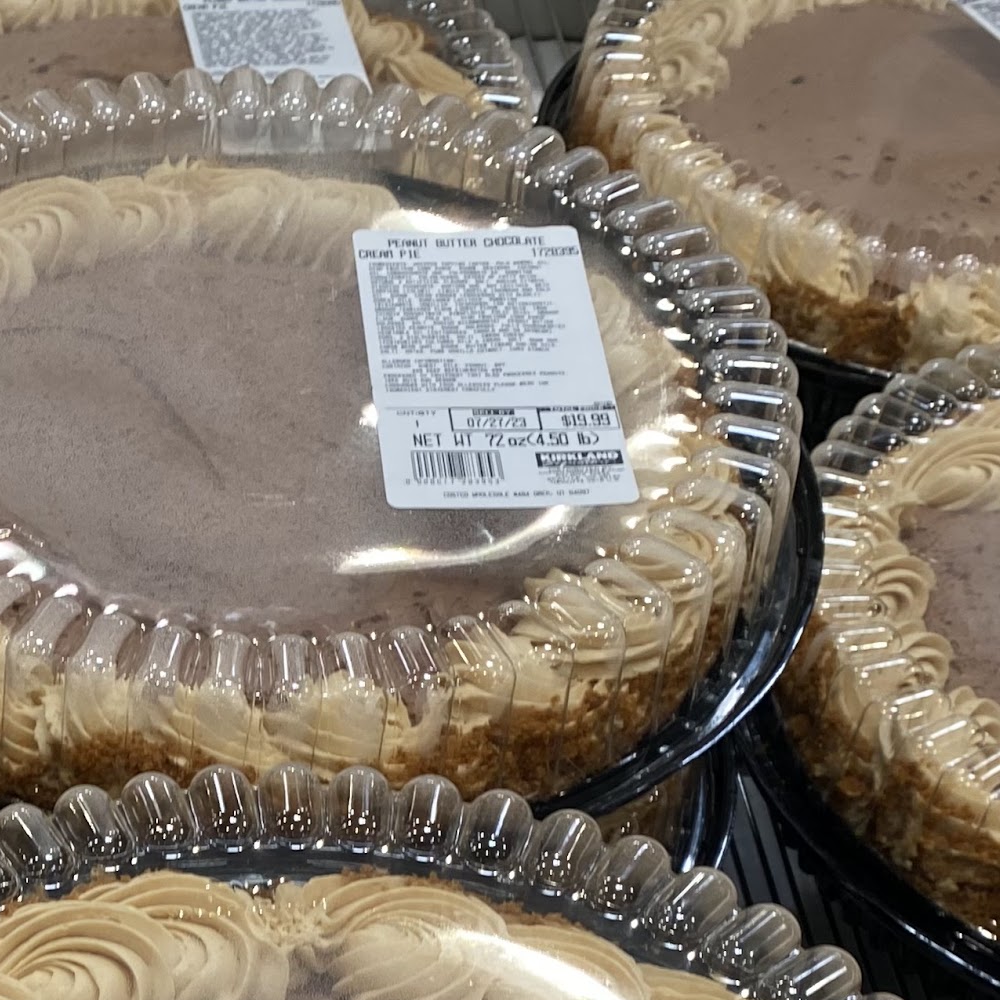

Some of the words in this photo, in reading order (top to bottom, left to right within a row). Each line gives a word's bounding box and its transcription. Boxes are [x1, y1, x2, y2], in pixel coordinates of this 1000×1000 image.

[387, 238, 428, 248] PEANUT
[435, 237, 477, 247] BUTTER
[482, 236, 546, 247] CHOCOLATE
[358, 249, 393, 259] CREAM
[399, 249, 421, 258] PIE
[466, 416, 527, 427] 07/27/23
[560, 413, 611, 426] $19.99
[413, 433, 443, 447] NET
[453, 432, 474, 446] WT
[539, 451, 619, 461] KIRKLAND
